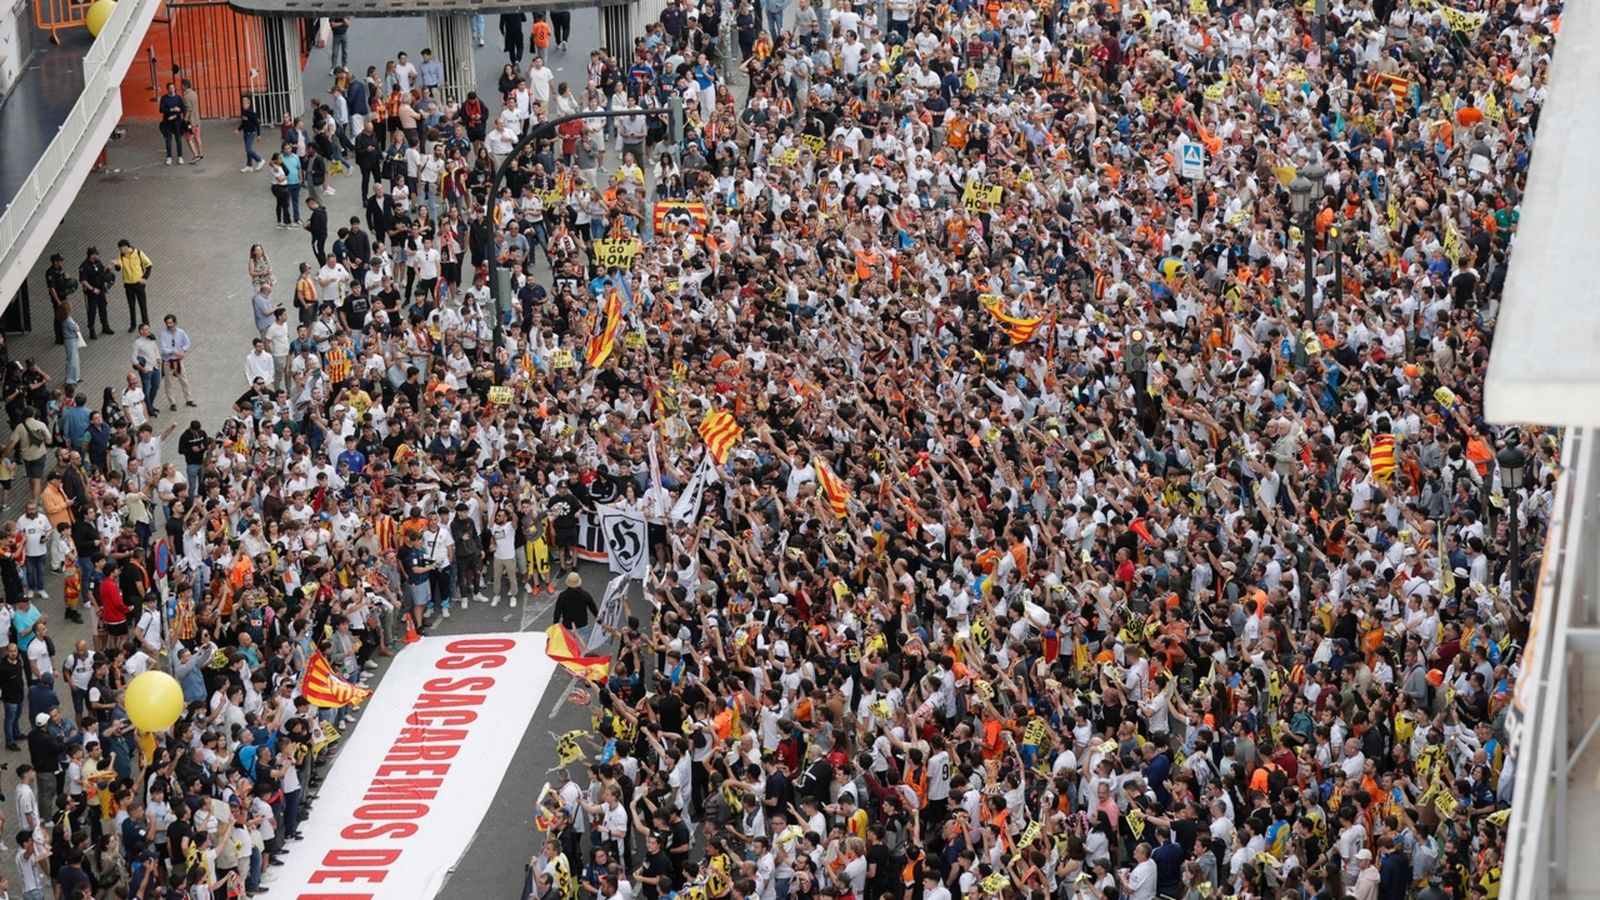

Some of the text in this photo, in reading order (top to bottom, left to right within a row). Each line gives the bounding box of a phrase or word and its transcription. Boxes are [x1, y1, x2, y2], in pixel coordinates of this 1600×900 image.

[971, 181, 994, 193] LIM
[965, 198, 1001, 209] HO
[609, 246, 625, 254] GO
[435, 638, 516, 670] OS
[340, 676, 496, 840] SACAREMOS
[942, 763, 949, 781] 9
[307, 849, 403, 884] DE
